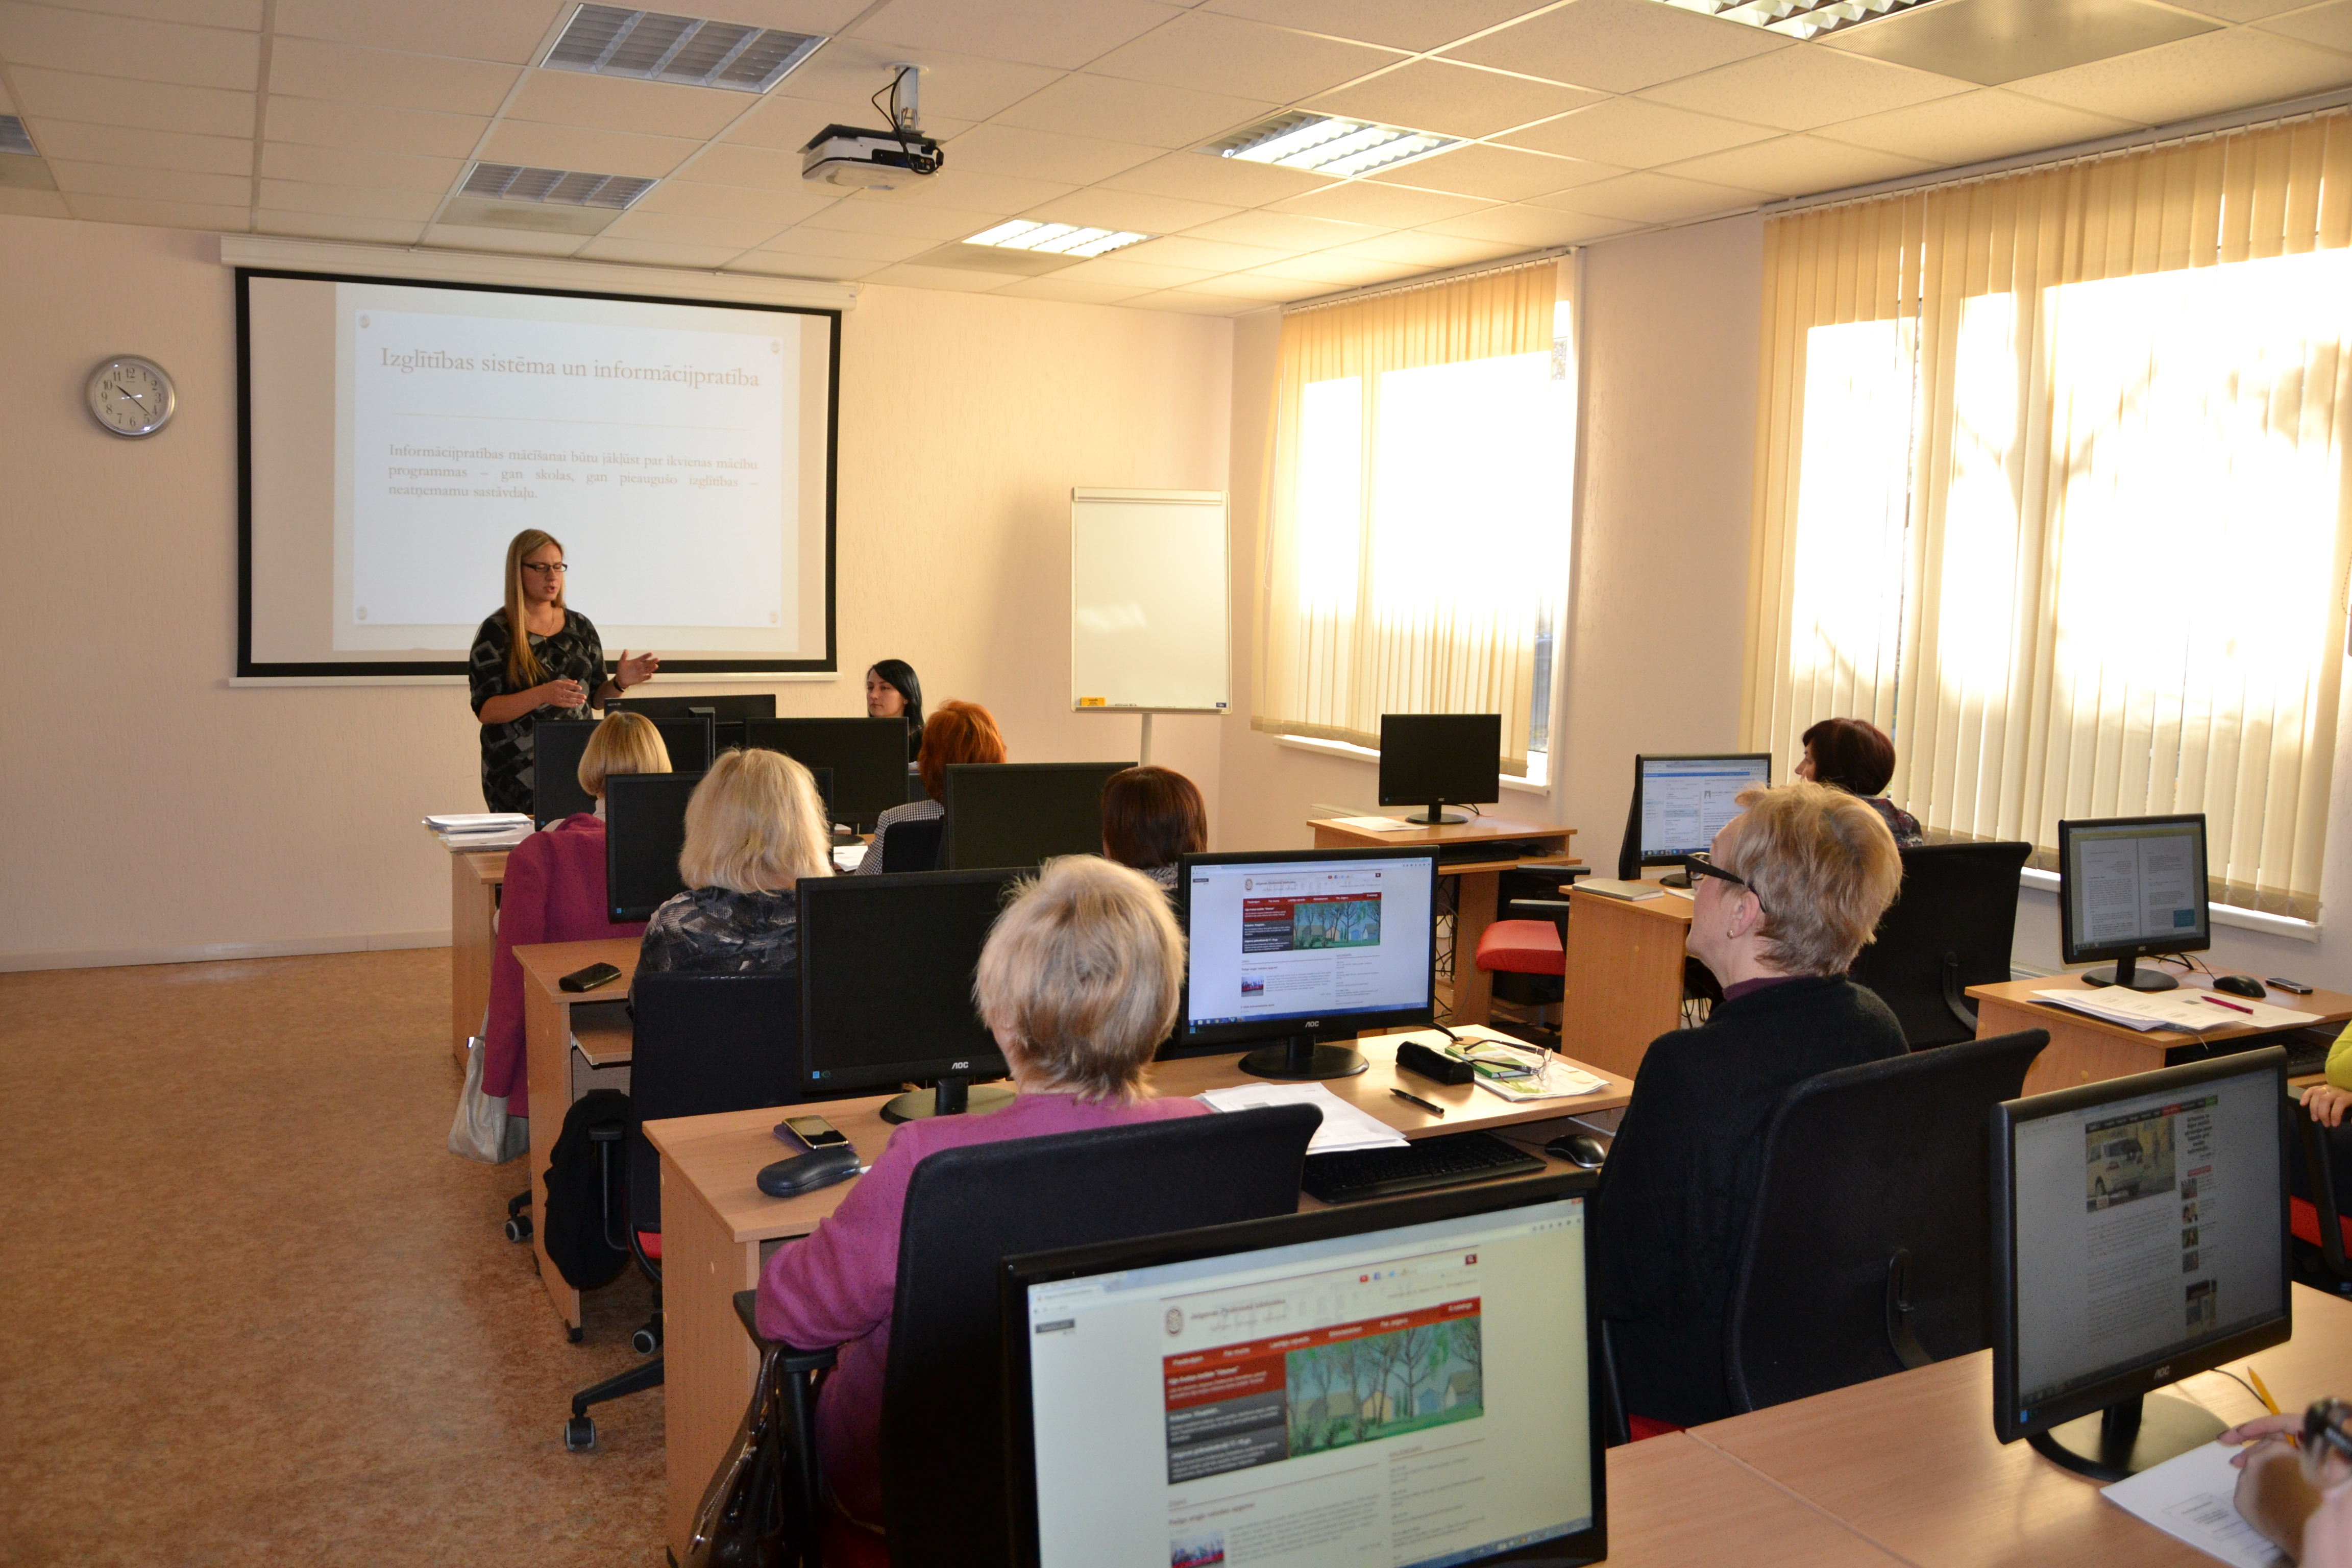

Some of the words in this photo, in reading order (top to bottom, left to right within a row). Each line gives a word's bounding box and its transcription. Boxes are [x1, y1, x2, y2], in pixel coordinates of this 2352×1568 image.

[126, 368, 135, 378] 12
[381, 348, 474, 374] Izglītības
[482, 354, 556, 375] sistēma
[562, 364, 586, 376] un
[594, 359, 759, 389] informācijpratība
[113, 371, 121, 381] 11
[143, 372, 146, 381] 1
[104, 380, 112, 390] 10
[151, 380, 157, 390] 2
[101, 391, 107, 402] 9
[155, 393, 161, 403] 3
[106, 404, 112, 414] 8
[152, 405, 157, 415] 4
[117, 413, 122, 424] 7
[130, 416, 135, 427] 6
[144, 414, 150, 424] 5
[389, 444, 504, 461] Informācijpratības
[509, 450, 566, 461] mācīšanai
[571, 451, 598, 462] būtu
[603, 452, 640, 466] jākļūst
[644, 457, 663, 469] par
[667, 455, 712, 467] ikvienas
[717, 458, 757, 469] mācību
[388, 467, 467, 479] programmas
[501, 471, 523, 482] gan
[535, 468, 574, 482] skolas,
[586, 474, 607, 485] gan
[619, 472, 677, 487] pieaugušo
[689, 474, 738, 488] izglītības
[389, 486, 469, 497] neatņemamu
[474, 489, 538, 500] sastāvdaļu.
[2154, 1365, 2170, 1379] AOC
